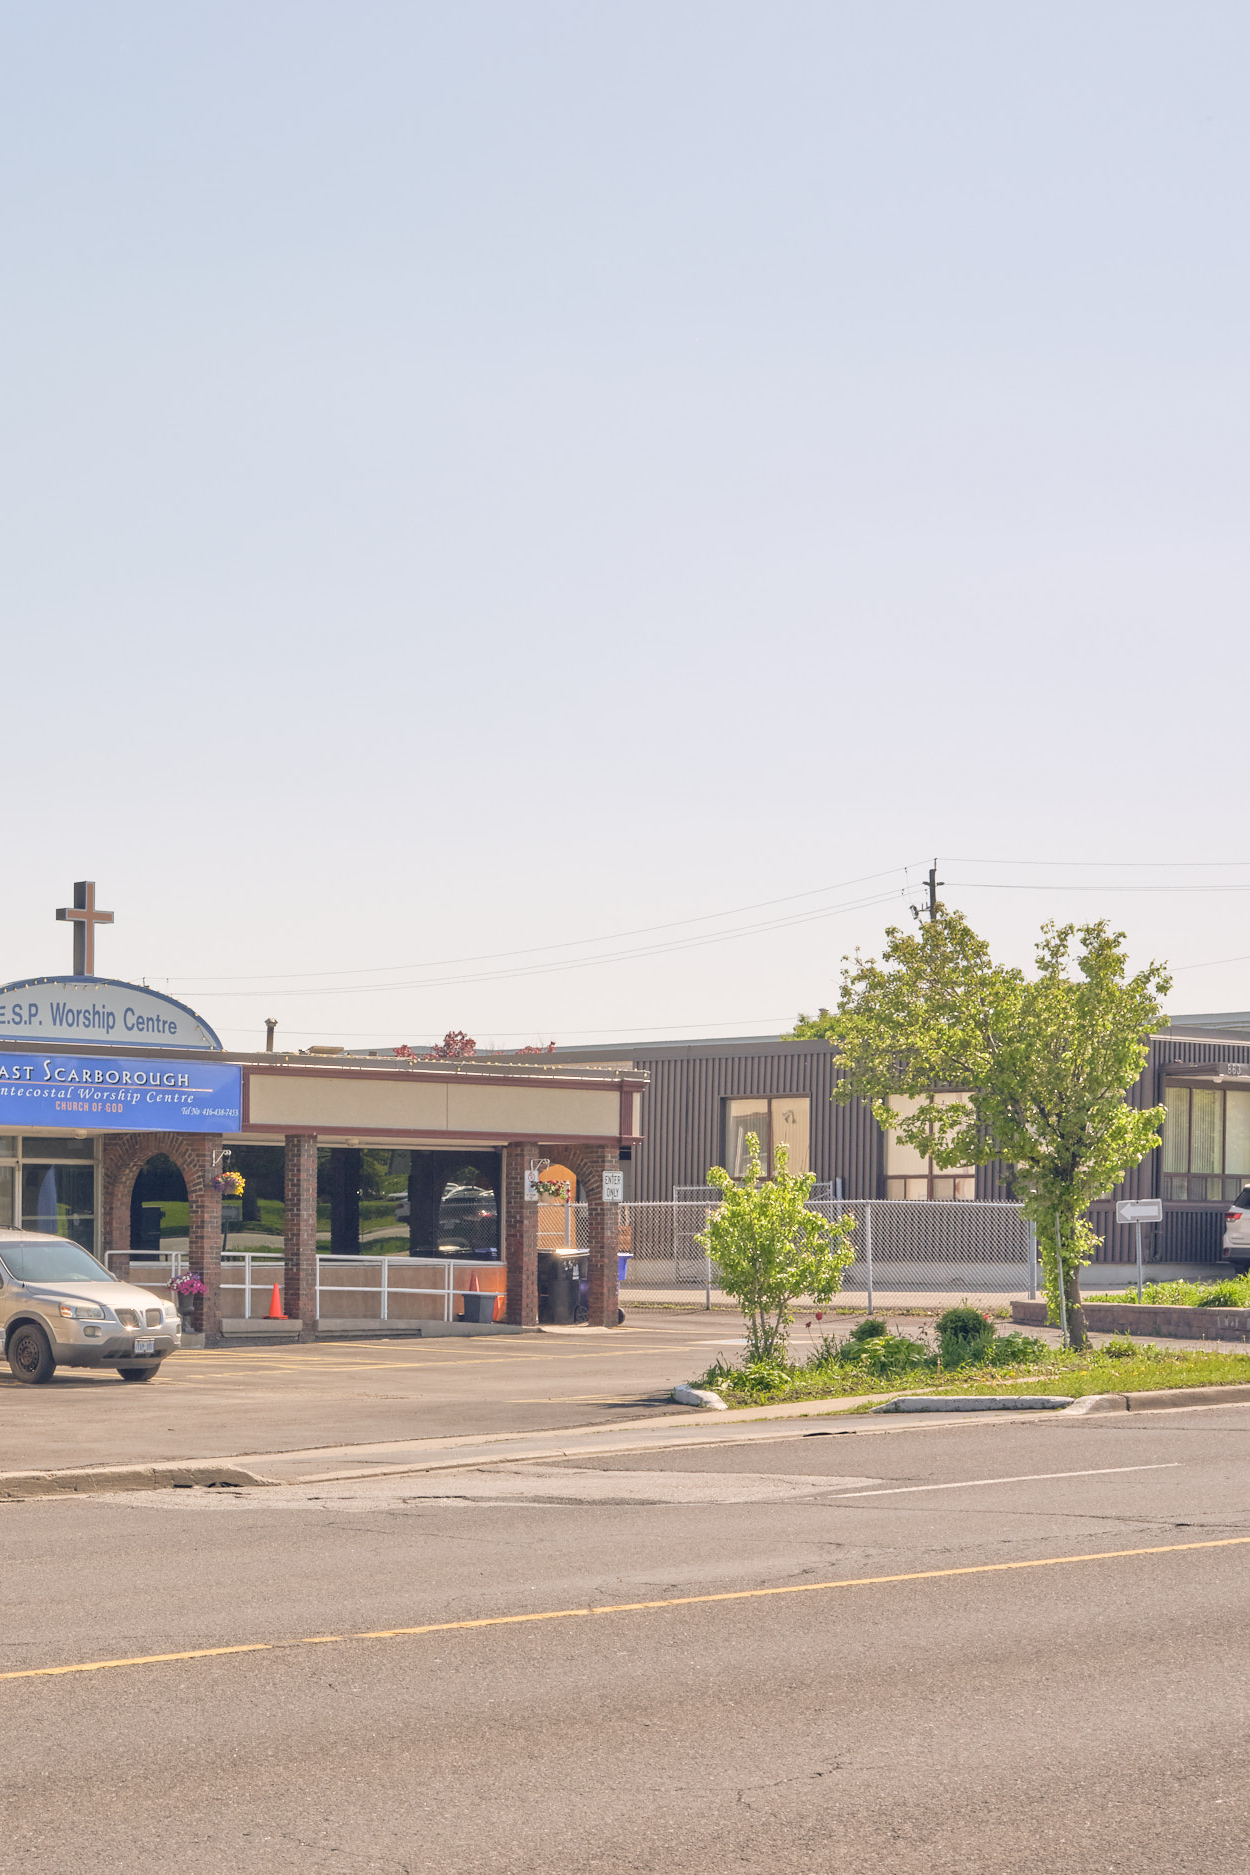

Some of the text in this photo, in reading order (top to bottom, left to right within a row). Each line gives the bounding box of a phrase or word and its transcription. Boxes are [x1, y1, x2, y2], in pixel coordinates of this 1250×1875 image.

[50, 1002, 116, 1034] Worship
[123, 1007, 178, 1035] Centre
[43, 1059, 190, 1087] SCARBOROUGH
[1227, 1063, 1242, 1075] 863
[77, 1087, 141, 1104] Worship
[146, 1091, 195, 1104] Centre
[55, 1101, 124, 1113] CHURCH OF GOD
[181, 1106, 191, 1115] Tel
[604, 1174, 621, 1185] ENTER
[606, 1187, 620, 1198] ONLY
